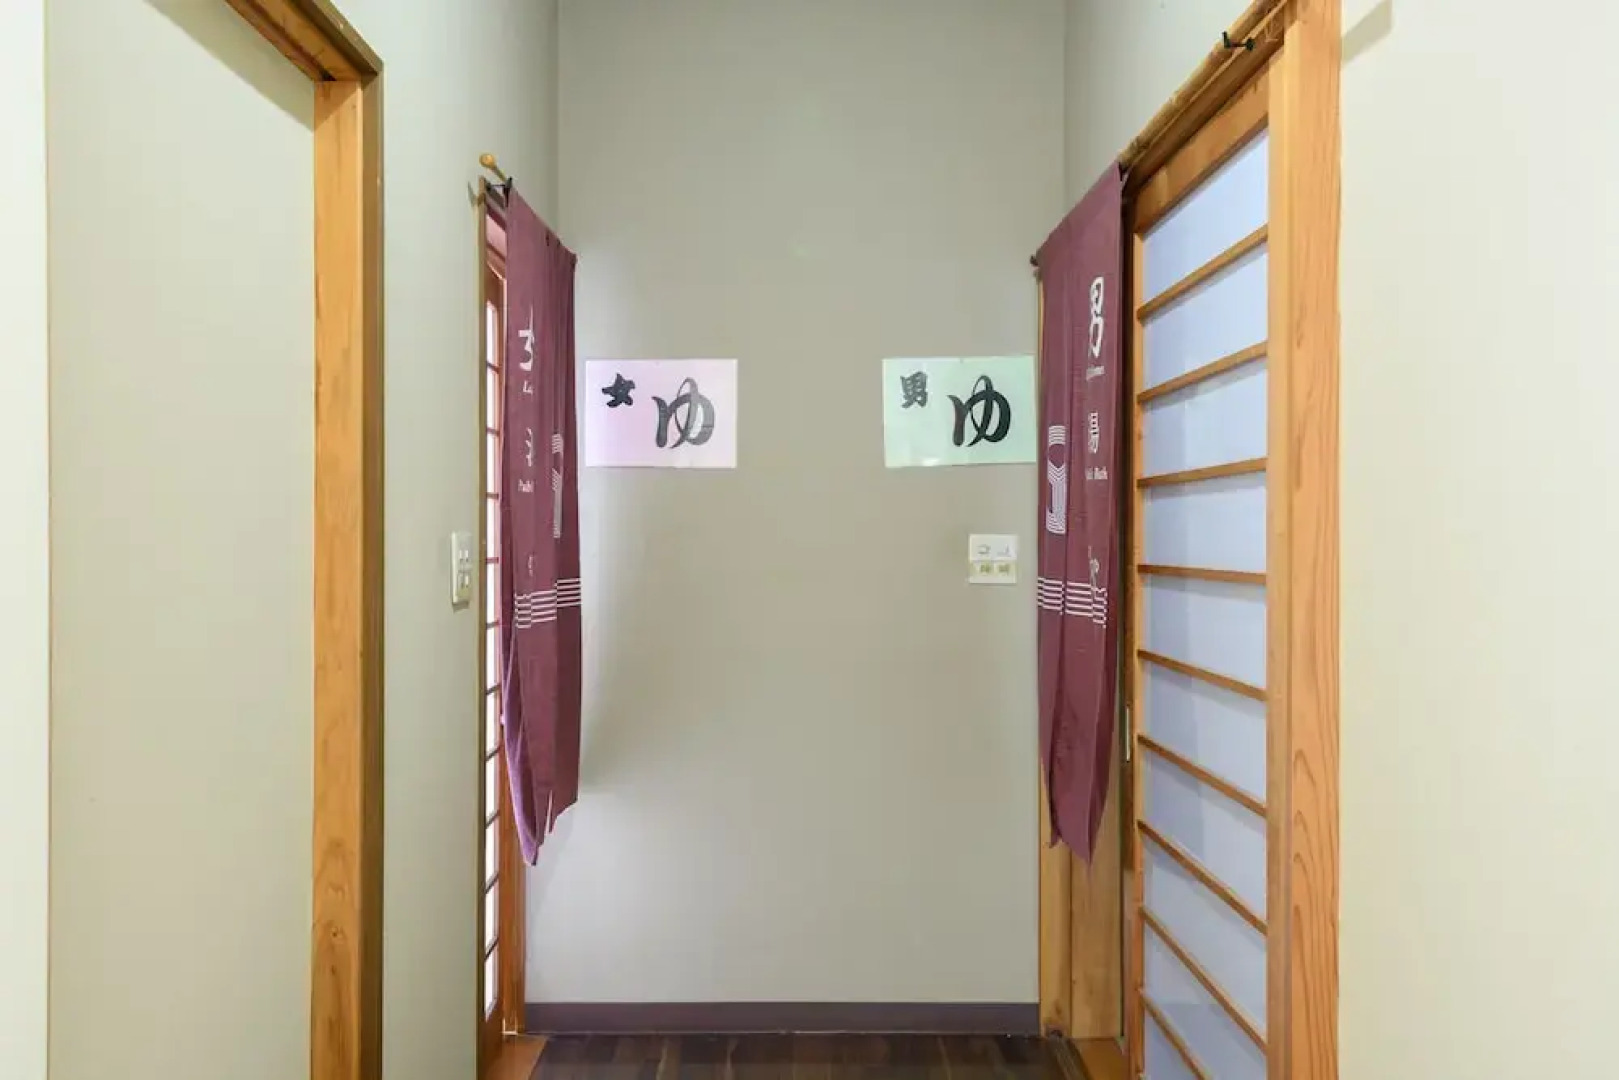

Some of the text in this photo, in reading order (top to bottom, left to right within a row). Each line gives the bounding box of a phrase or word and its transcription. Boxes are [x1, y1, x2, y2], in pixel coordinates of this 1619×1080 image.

[602, 373, 715, 450] 女 ゆ
[900, 371, 1012, 448] 男 ゆ
